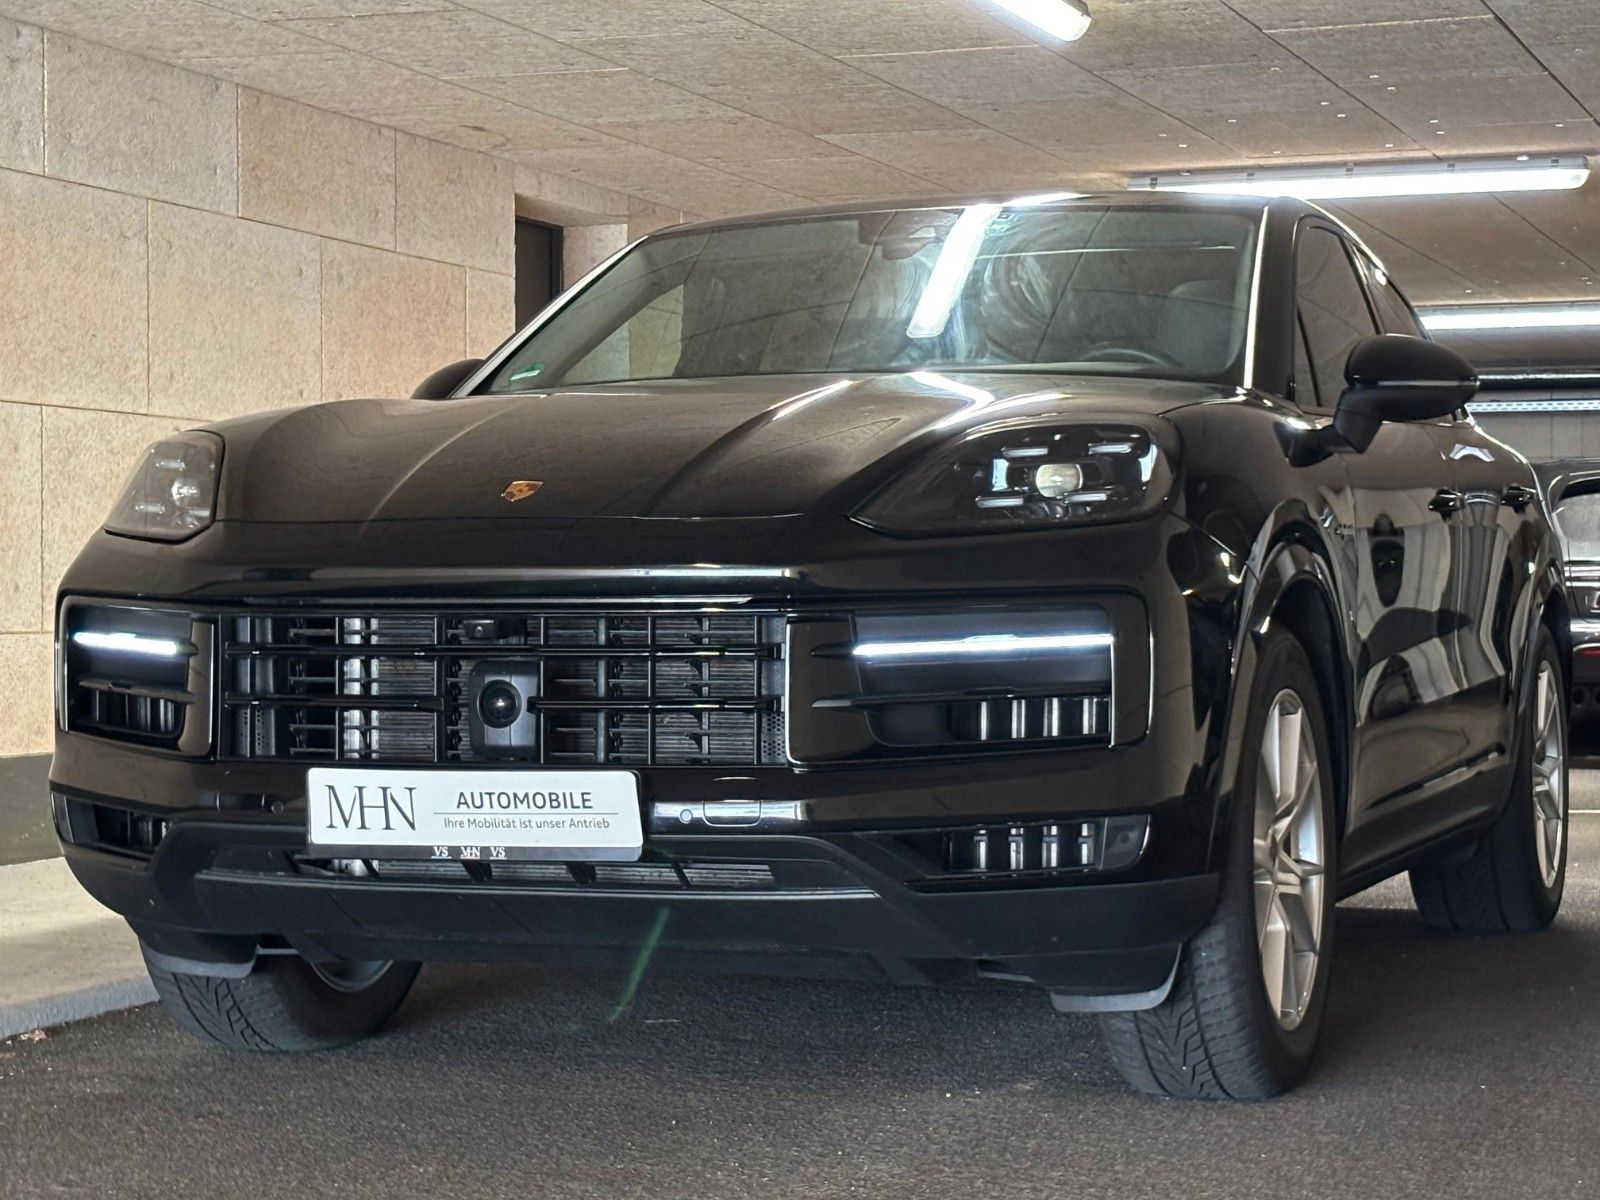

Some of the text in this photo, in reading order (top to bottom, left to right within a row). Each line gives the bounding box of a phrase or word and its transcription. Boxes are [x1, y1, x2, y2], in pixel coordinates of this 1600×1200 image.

[324, 784, 417, 831] MHN
[456, 791, 594, 809] AUTOMOBILE
[444, 818, 610, 829] Ihre Mobilität ist unser Antrieb
